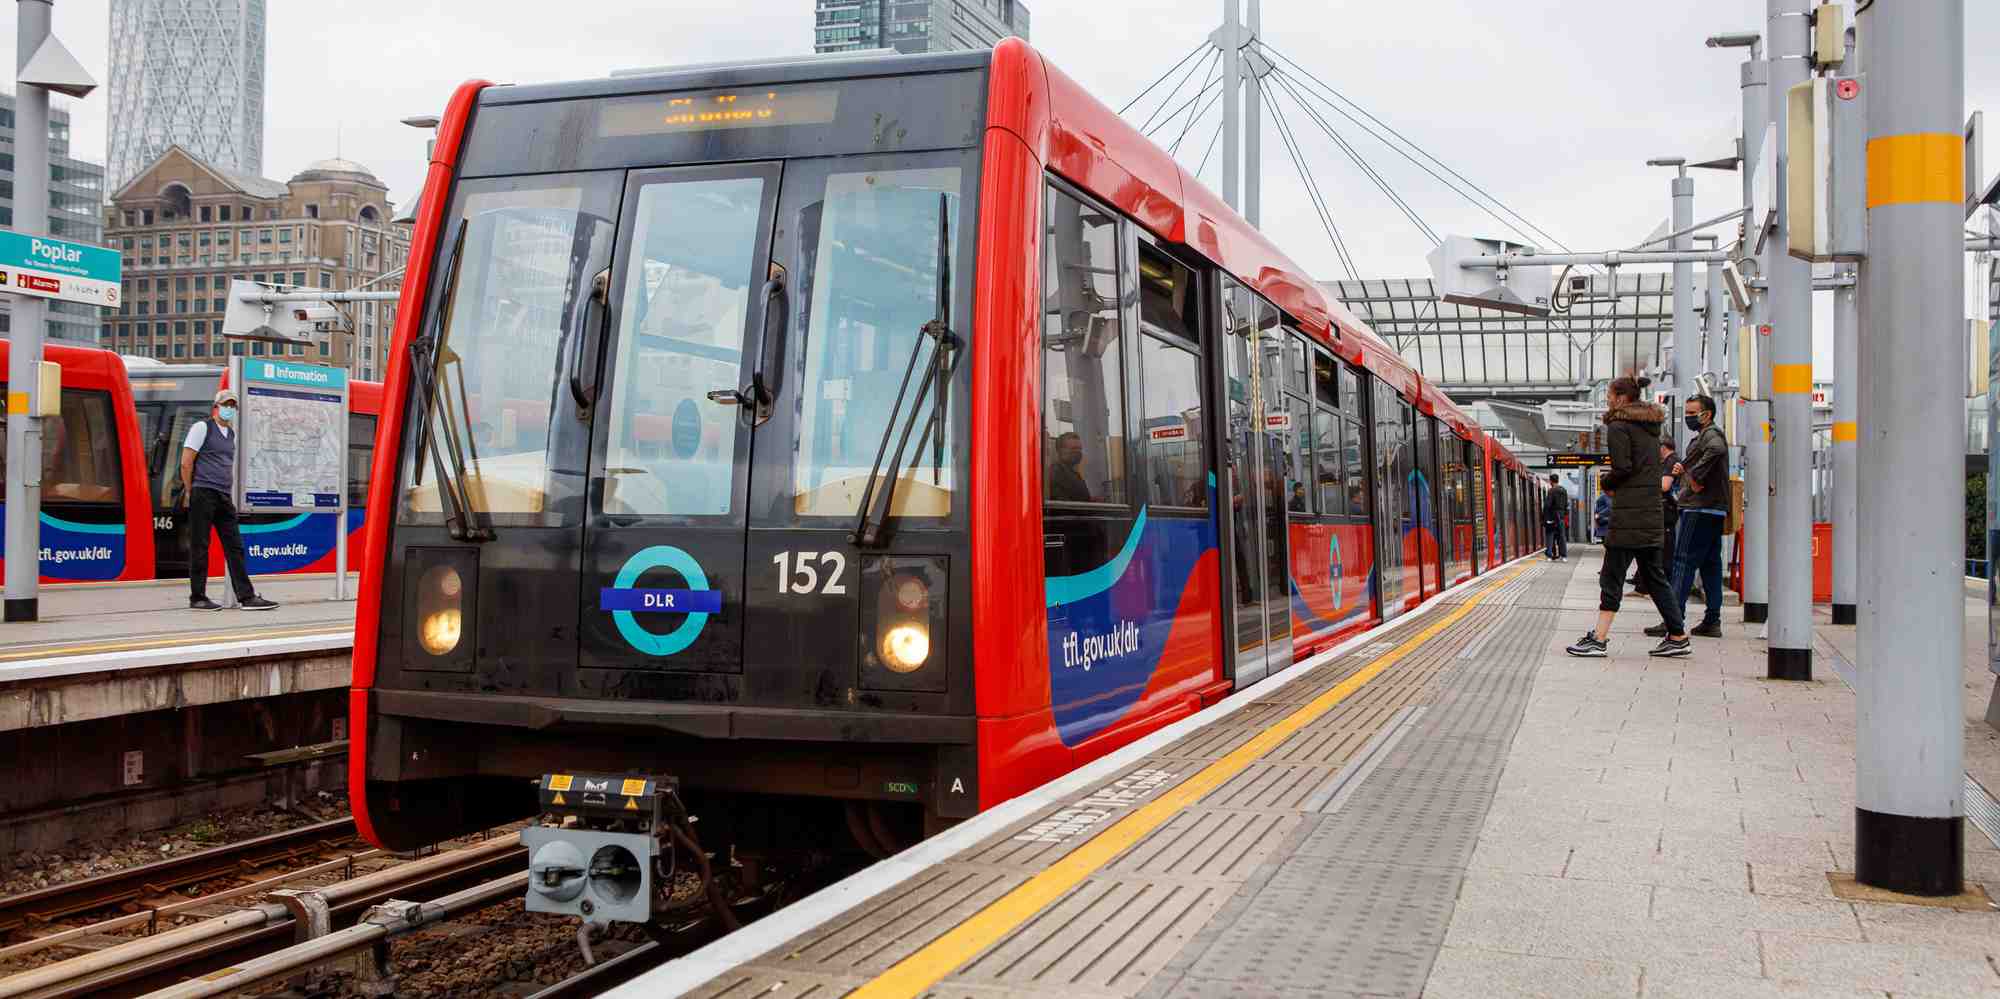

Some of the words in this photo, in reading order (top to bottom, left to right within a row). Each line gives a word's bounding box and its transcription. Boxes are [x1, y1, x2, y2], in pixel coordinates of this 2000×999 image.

[31, 239, 82, 263] Poplar
[276, 366, 328, 383] Information
[153, 516, 173, 530] 146
[38, 545, 113, 564] tfl.gov.uk/dlr
[248, 543, 308, 559] tfl.gov.uk/dlr
[773, 550, 847, 595] 152
[643, 593, 675, 608] DLR
[1063, 618, 1140, 672] tfl.gov.uk/dlr
[951, 776, 965, 794] A
